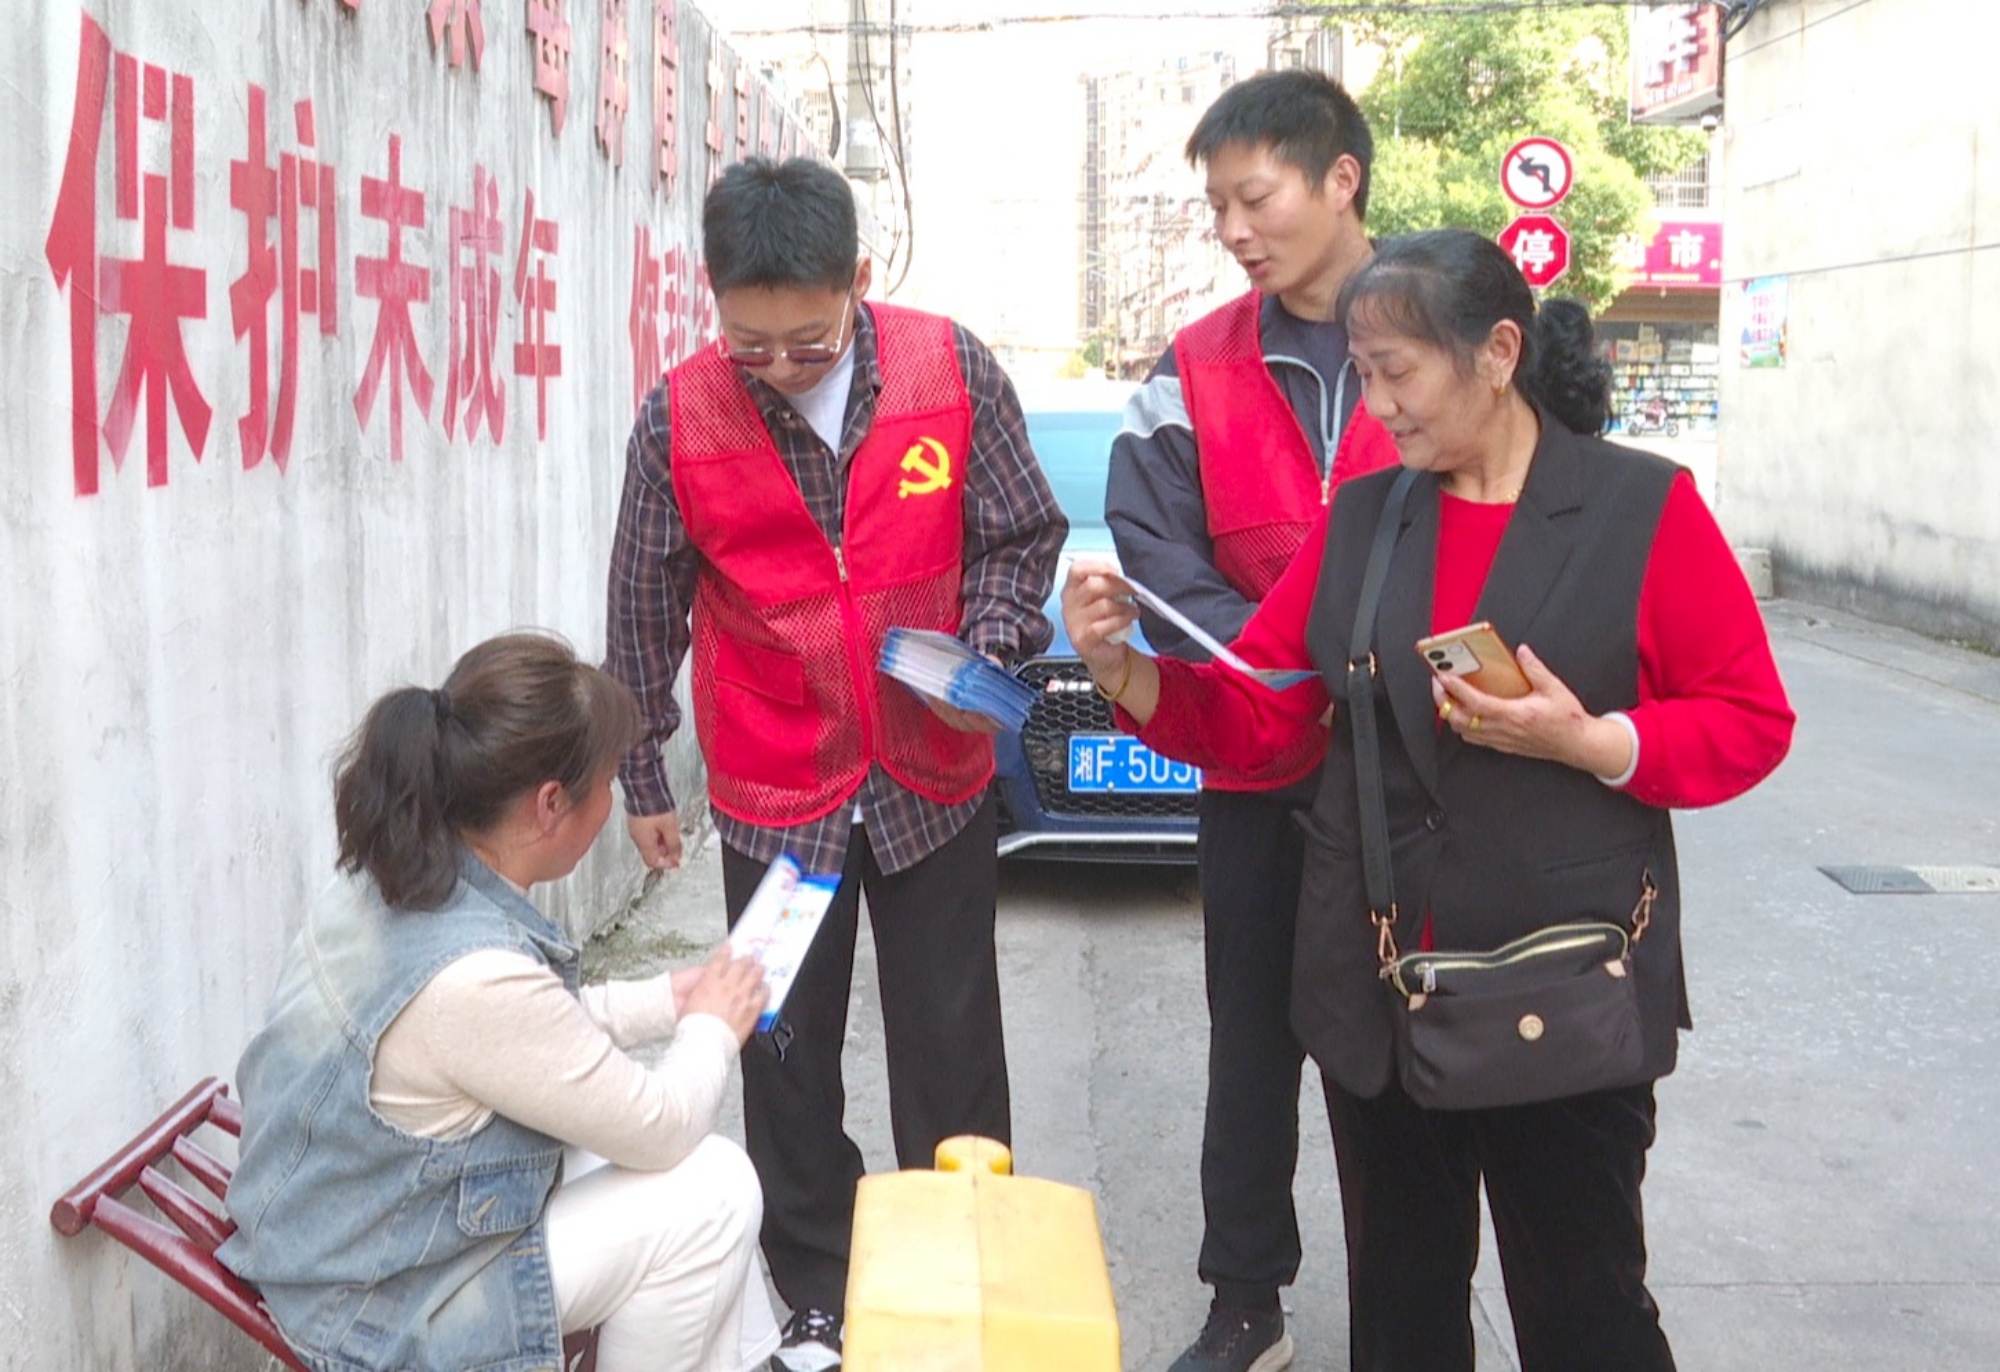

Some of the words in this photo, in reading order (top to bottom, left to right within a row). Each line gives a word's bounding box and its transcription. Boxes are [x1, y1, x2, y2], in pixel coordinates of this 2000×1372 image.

[45, 8, 562, 496] 保护未成年
[1512, 229, 1555, 273] 停
